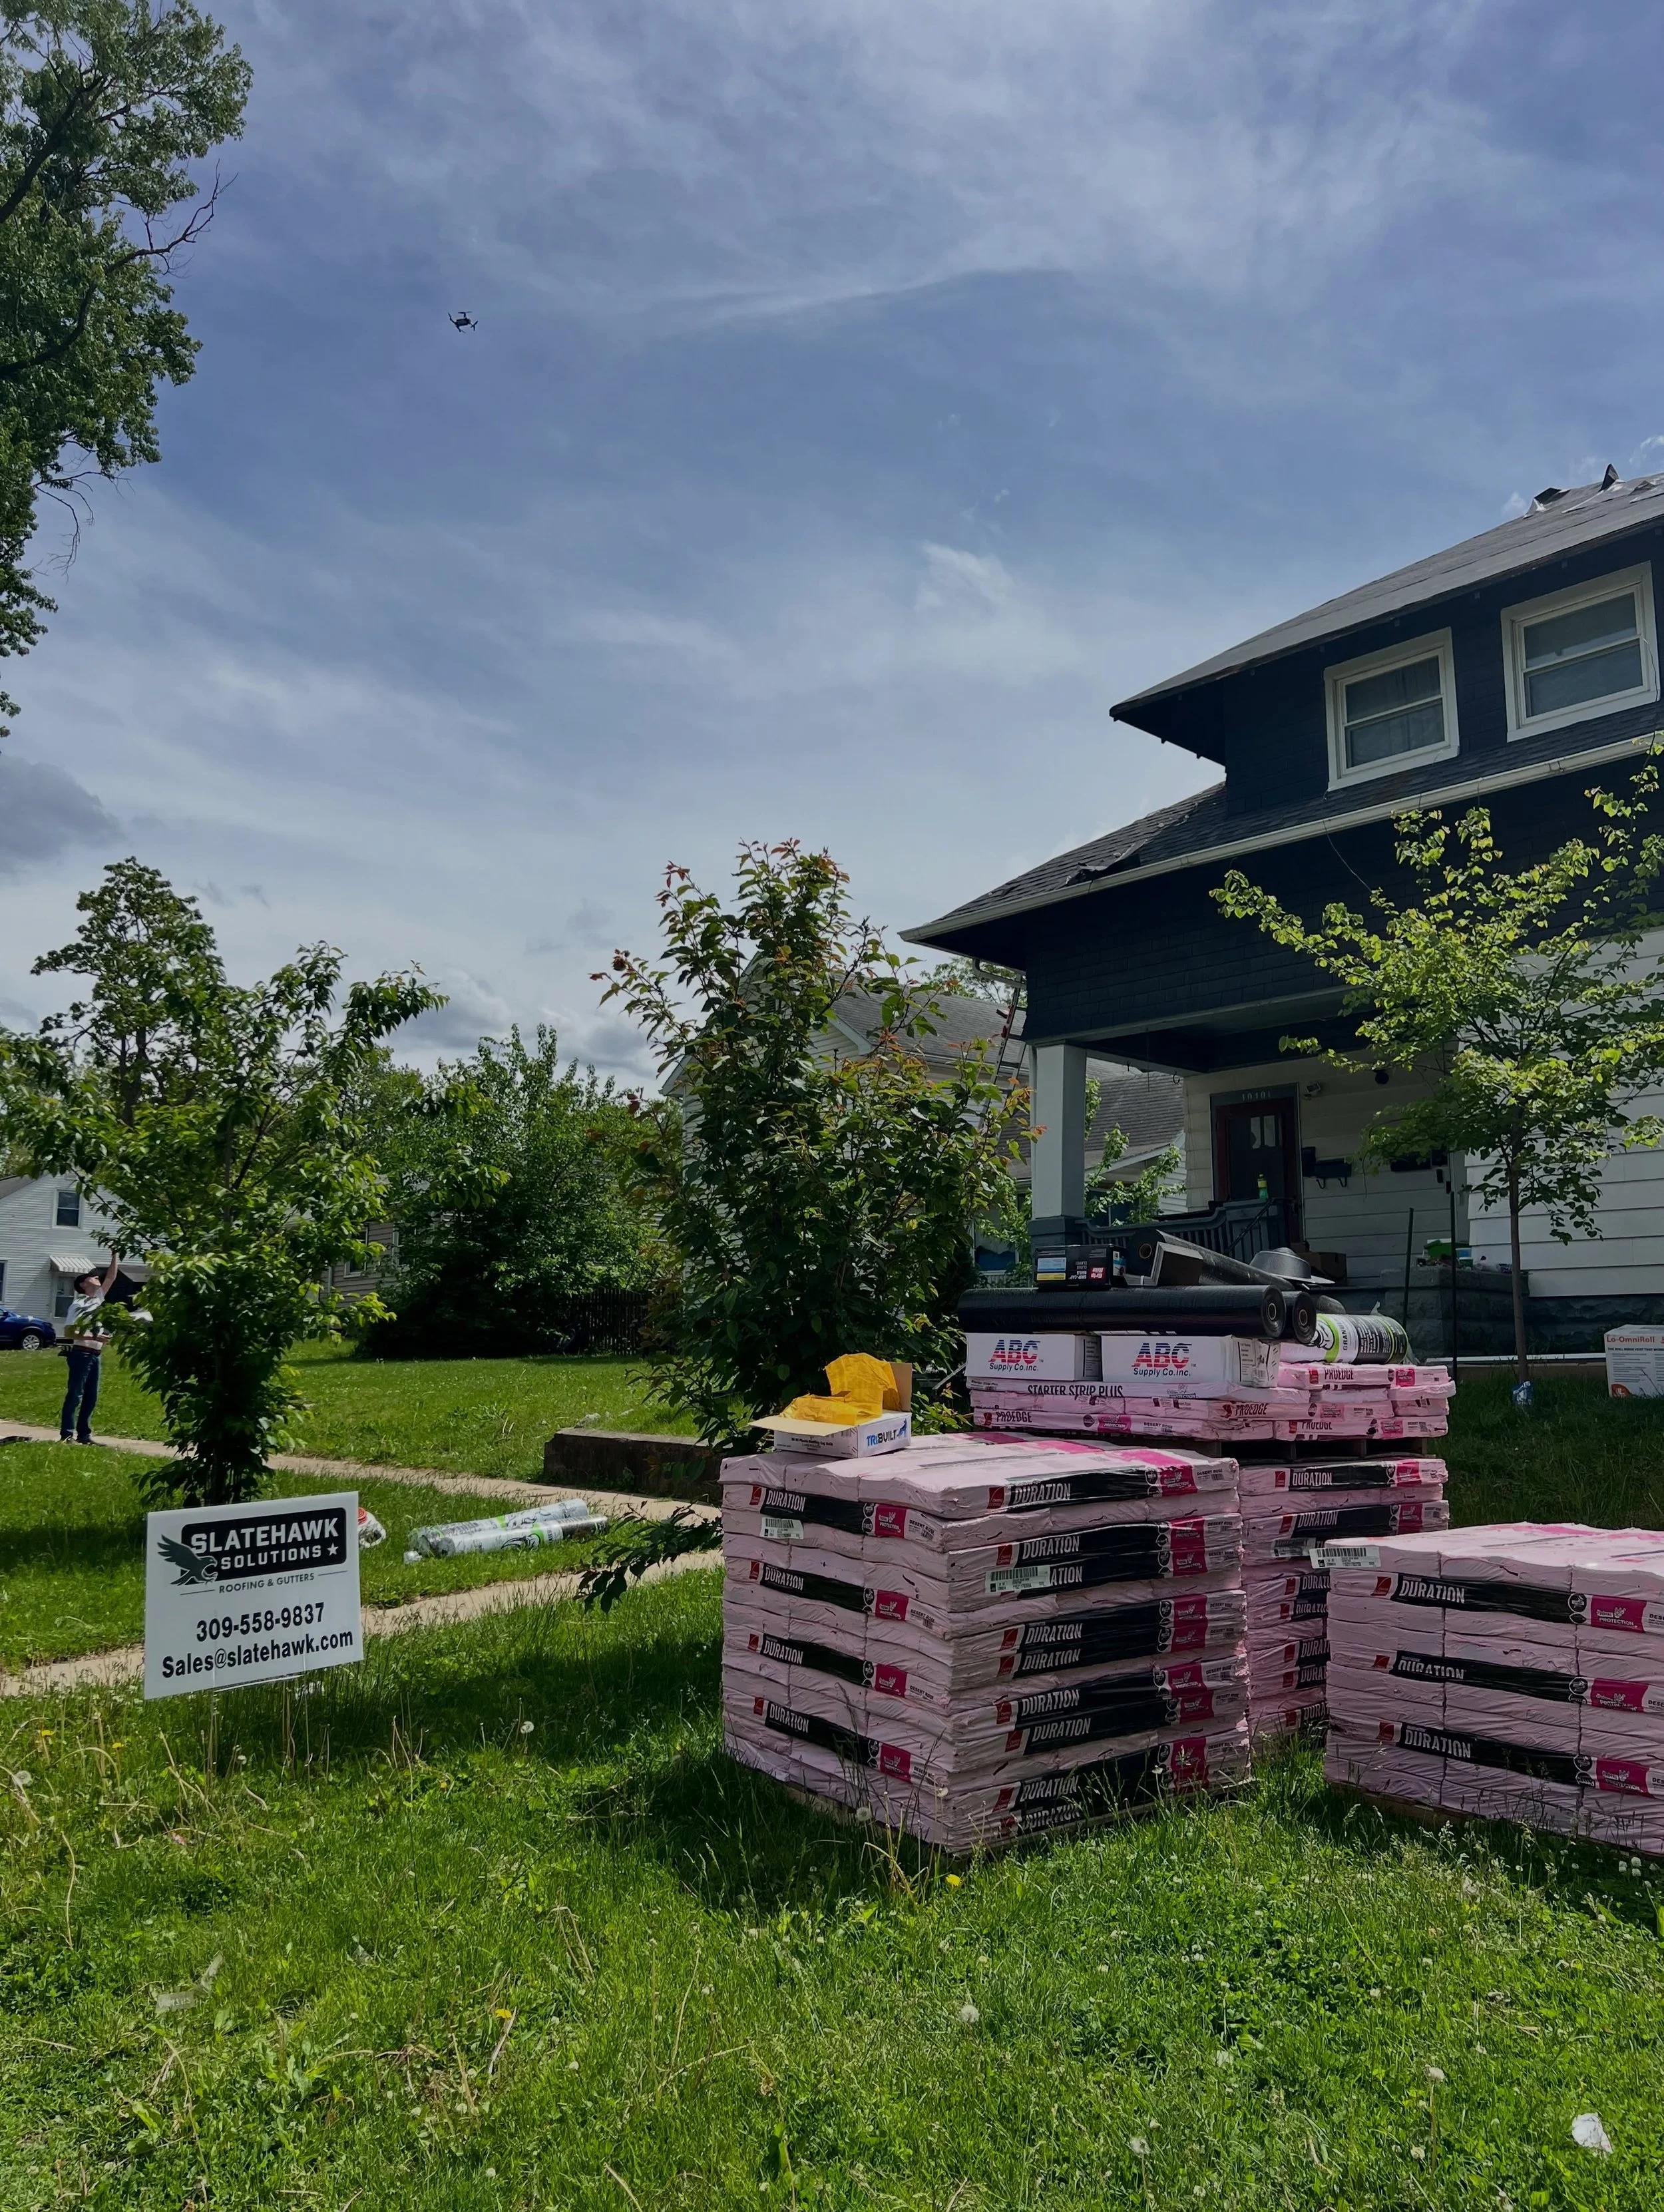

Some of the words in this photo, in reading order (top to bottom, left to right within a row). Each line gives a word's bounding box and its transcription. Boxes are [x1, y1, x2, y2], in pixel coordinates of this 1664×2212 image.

[988, 1339, 1041, 1365] ABC
[1132, 1343, 1192, 1369] ABC
[989, 1363, 1012, 1372] Supply
[1134, 1367, 1160, 1377] Supply
[1028, 1384, 1065, 1395] STARTER
[1069, 1385, 1096, 1397] STRIP
[1098, 1385, 1124, 1398] PLUS
[996, 1411, 1032, 1423] PROEDGE
[1235, 1403, 1269, 1416] PROEDGE
[1293, 1472, 1333, 1486] DURATION
[766, 1490, 805, 1512] DURATION
[1014, 1483, 1071, 1504] DURATION
[1298, 1510, 1339, 1528] DURATION
[190, 1518, 339, 1554] SLATEHAWK
[220, 1545, 321, 1570] SOLUTIONS
[1022, 1536, 1080, 1560] DURATION
[219, 1580, 264, 1594] ROOFING
[267, 1578, 274, 1587] &
[276, 1573, 315, 1586] GUTTERS
[765, 1566, 804, 1591] DURATION
[1050, 1566, 1082, 1586] ATION
[1302, 1576, 1330, 1590] DURATI
[1399, 1580, 1464, 1604] DURATION
[1296, 1603, 1327, 1614] DURATI
[196, 1602, 325, 1642] 309-558-9837
[1025, 1623, 1082, 1645] DURATION
[162, 1631, 353, 1678] Sales@slatehawk.com
[763, 1640, 803, 1664] DURATION
[1022, 1648, 1081, 1670] DURATION
[1301, 1638, 1330, 1658] DURAT
[1301, 1665, 1327, 1683] DURA
[1021, 1689, 1080, 1716] DURATION
[1305, 1702, 1330, 1719] DURA
[769, 1703, 809, 1733] DURATION
[1032, 1718, 1092, 1742] DURATION
[1405, 1730, 1471, 1759] DURATION
